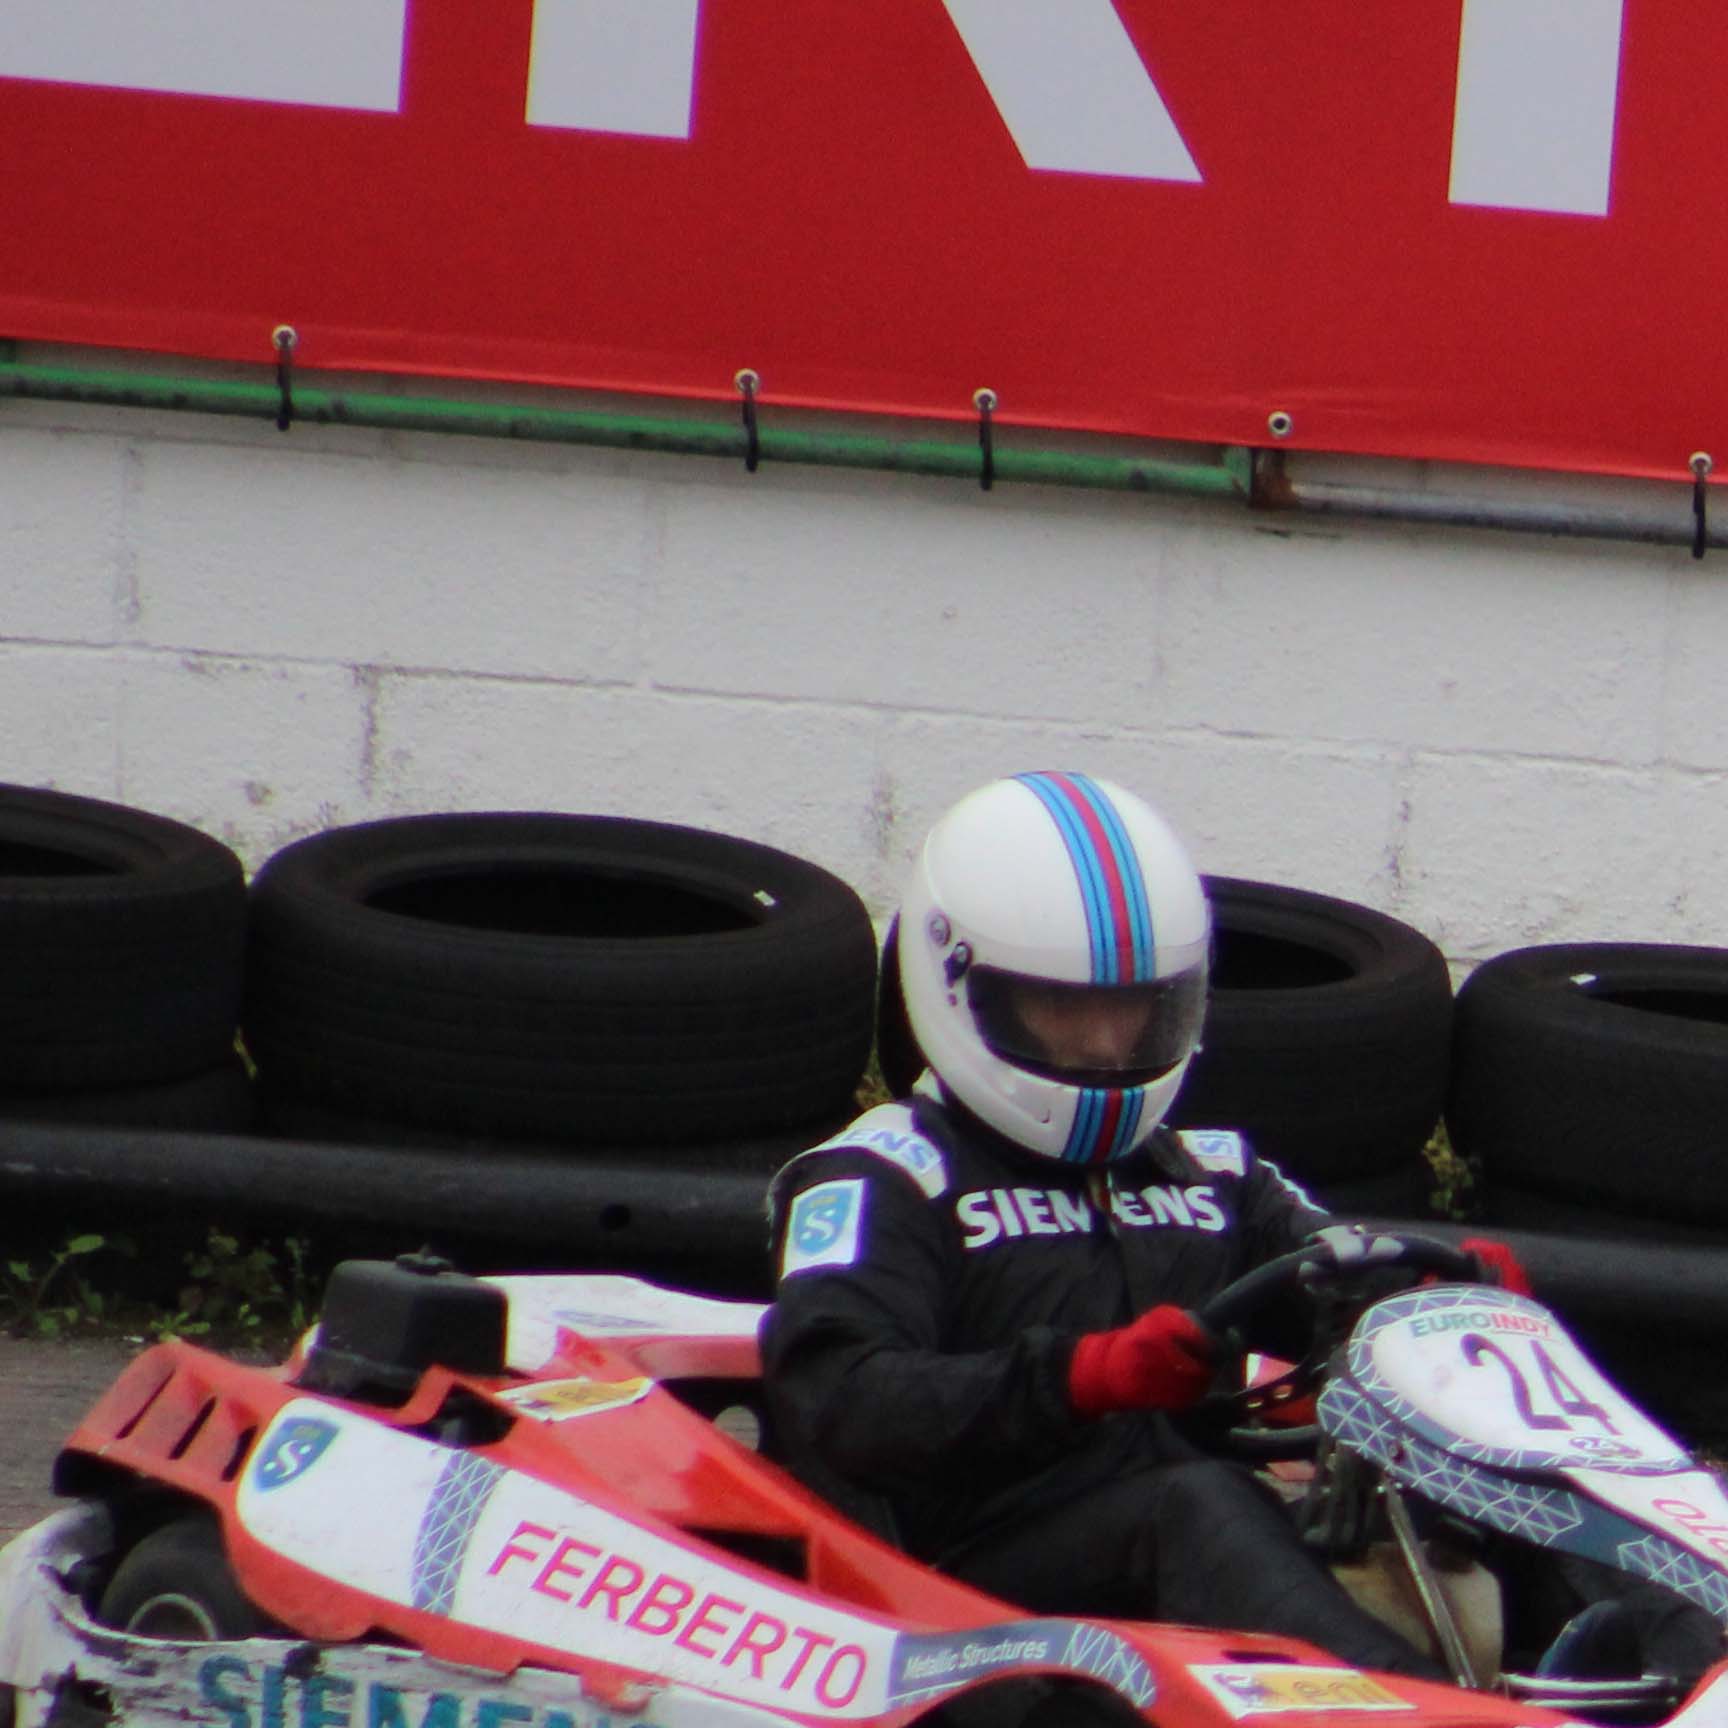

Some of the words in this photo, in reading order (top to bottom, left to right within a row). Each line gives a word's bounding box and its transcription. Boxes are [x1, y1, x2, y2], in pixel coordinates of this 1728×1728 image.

[1461, 1332, 1624, 1437] 24
[488, 1521, 869, 1709] FERBERTO
[960, 1637, 1049, 1668] Structures
